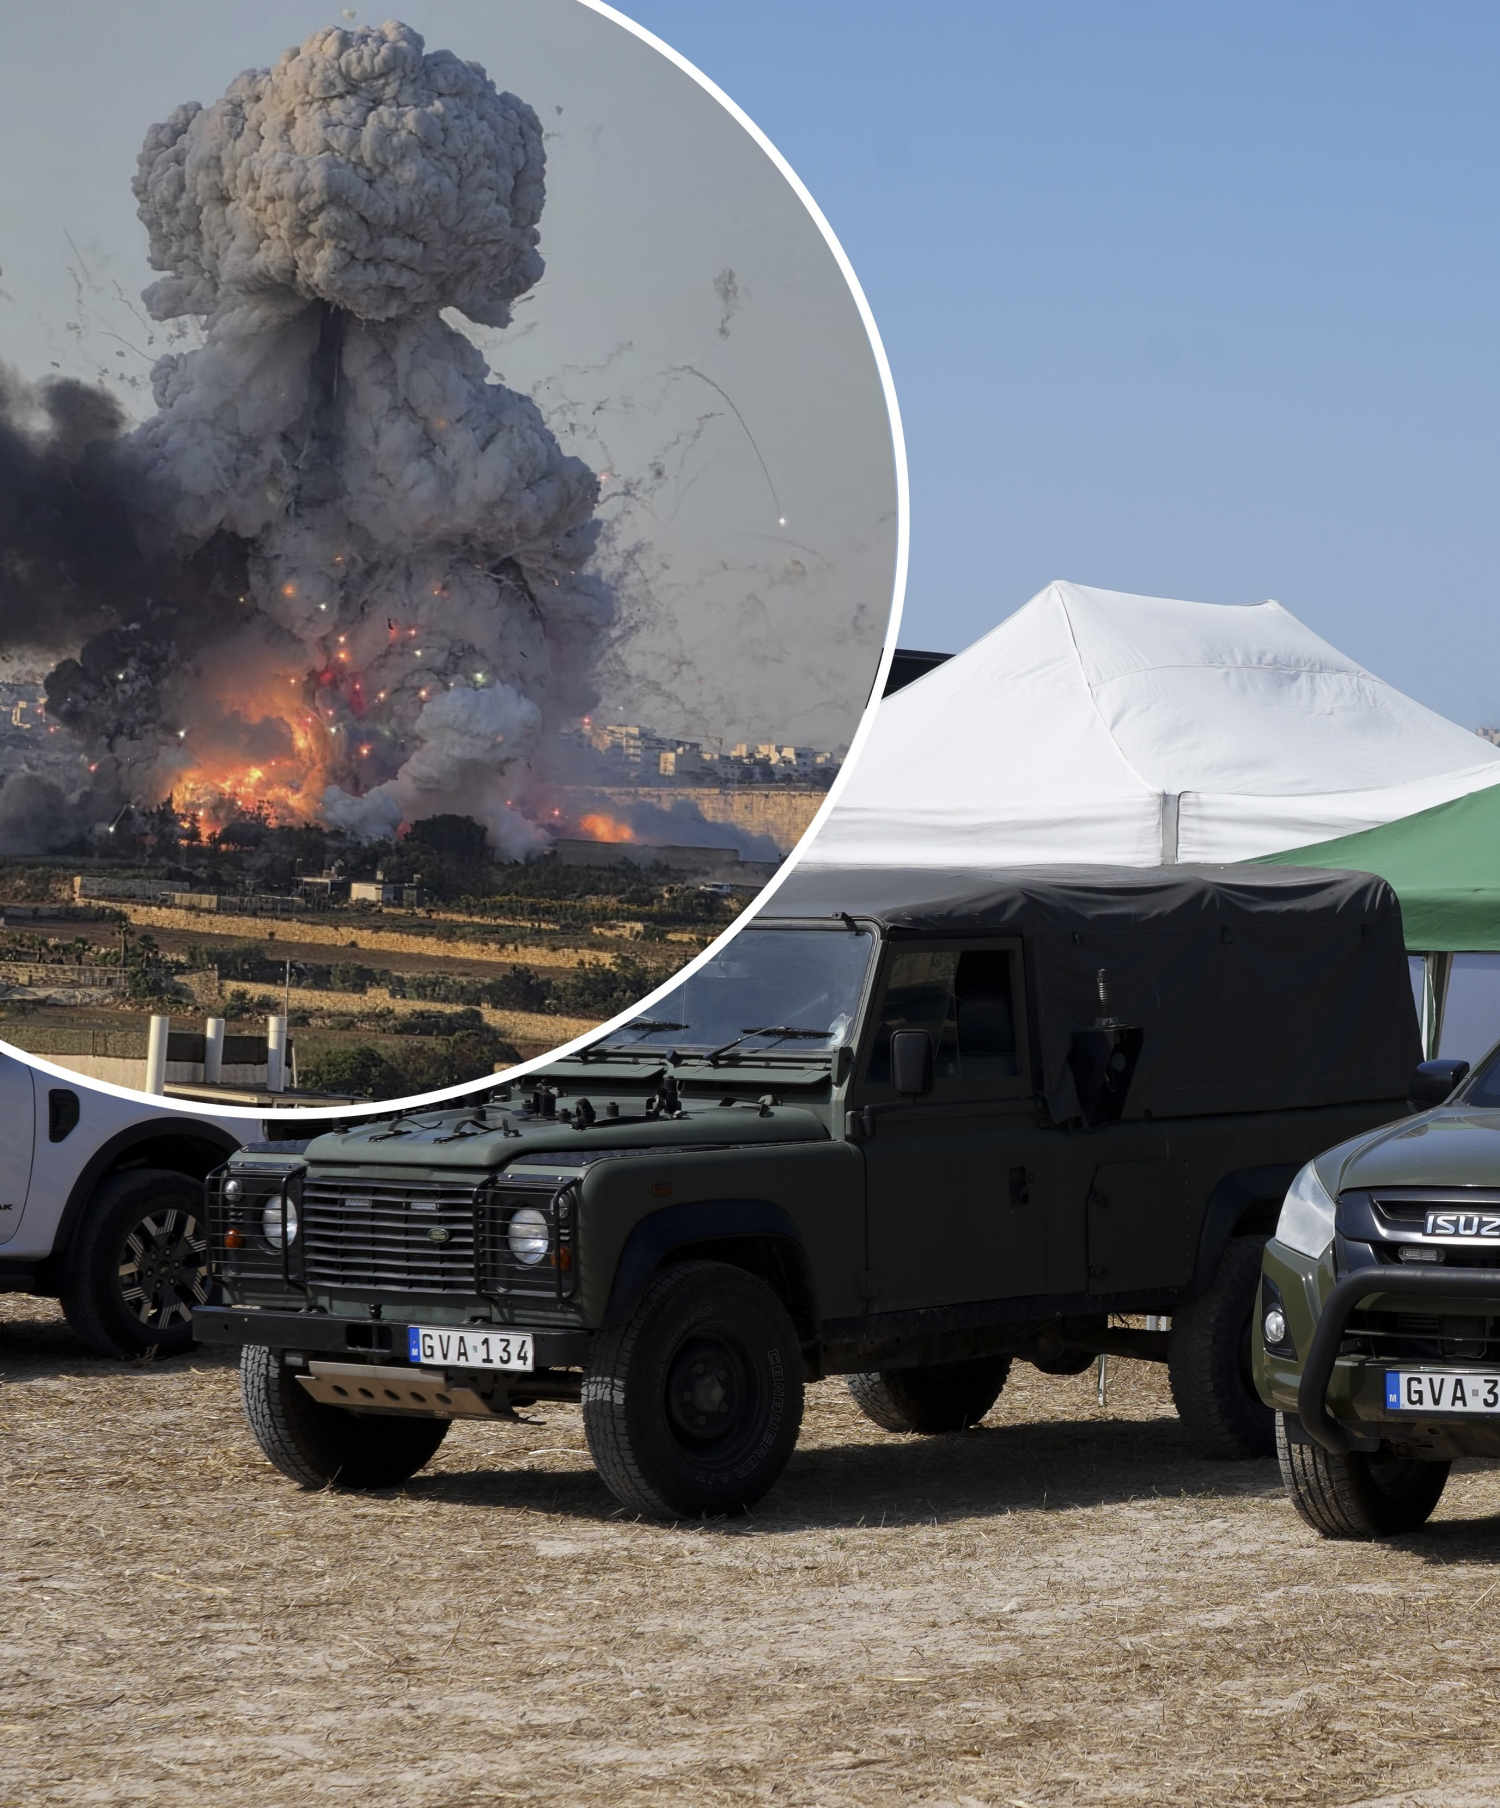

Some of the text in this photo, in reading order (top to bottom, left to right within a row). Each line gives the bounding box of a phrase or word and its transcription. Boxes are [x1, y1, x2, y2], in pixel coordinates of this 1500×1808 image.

[422, 1333, 528, 1366] GVA 134
[1389, 1394, 1397, 1403] M
[1406, 1377, 1467, 1407] GVA
[736, 1348, 785, 1479] CONQUEROR
